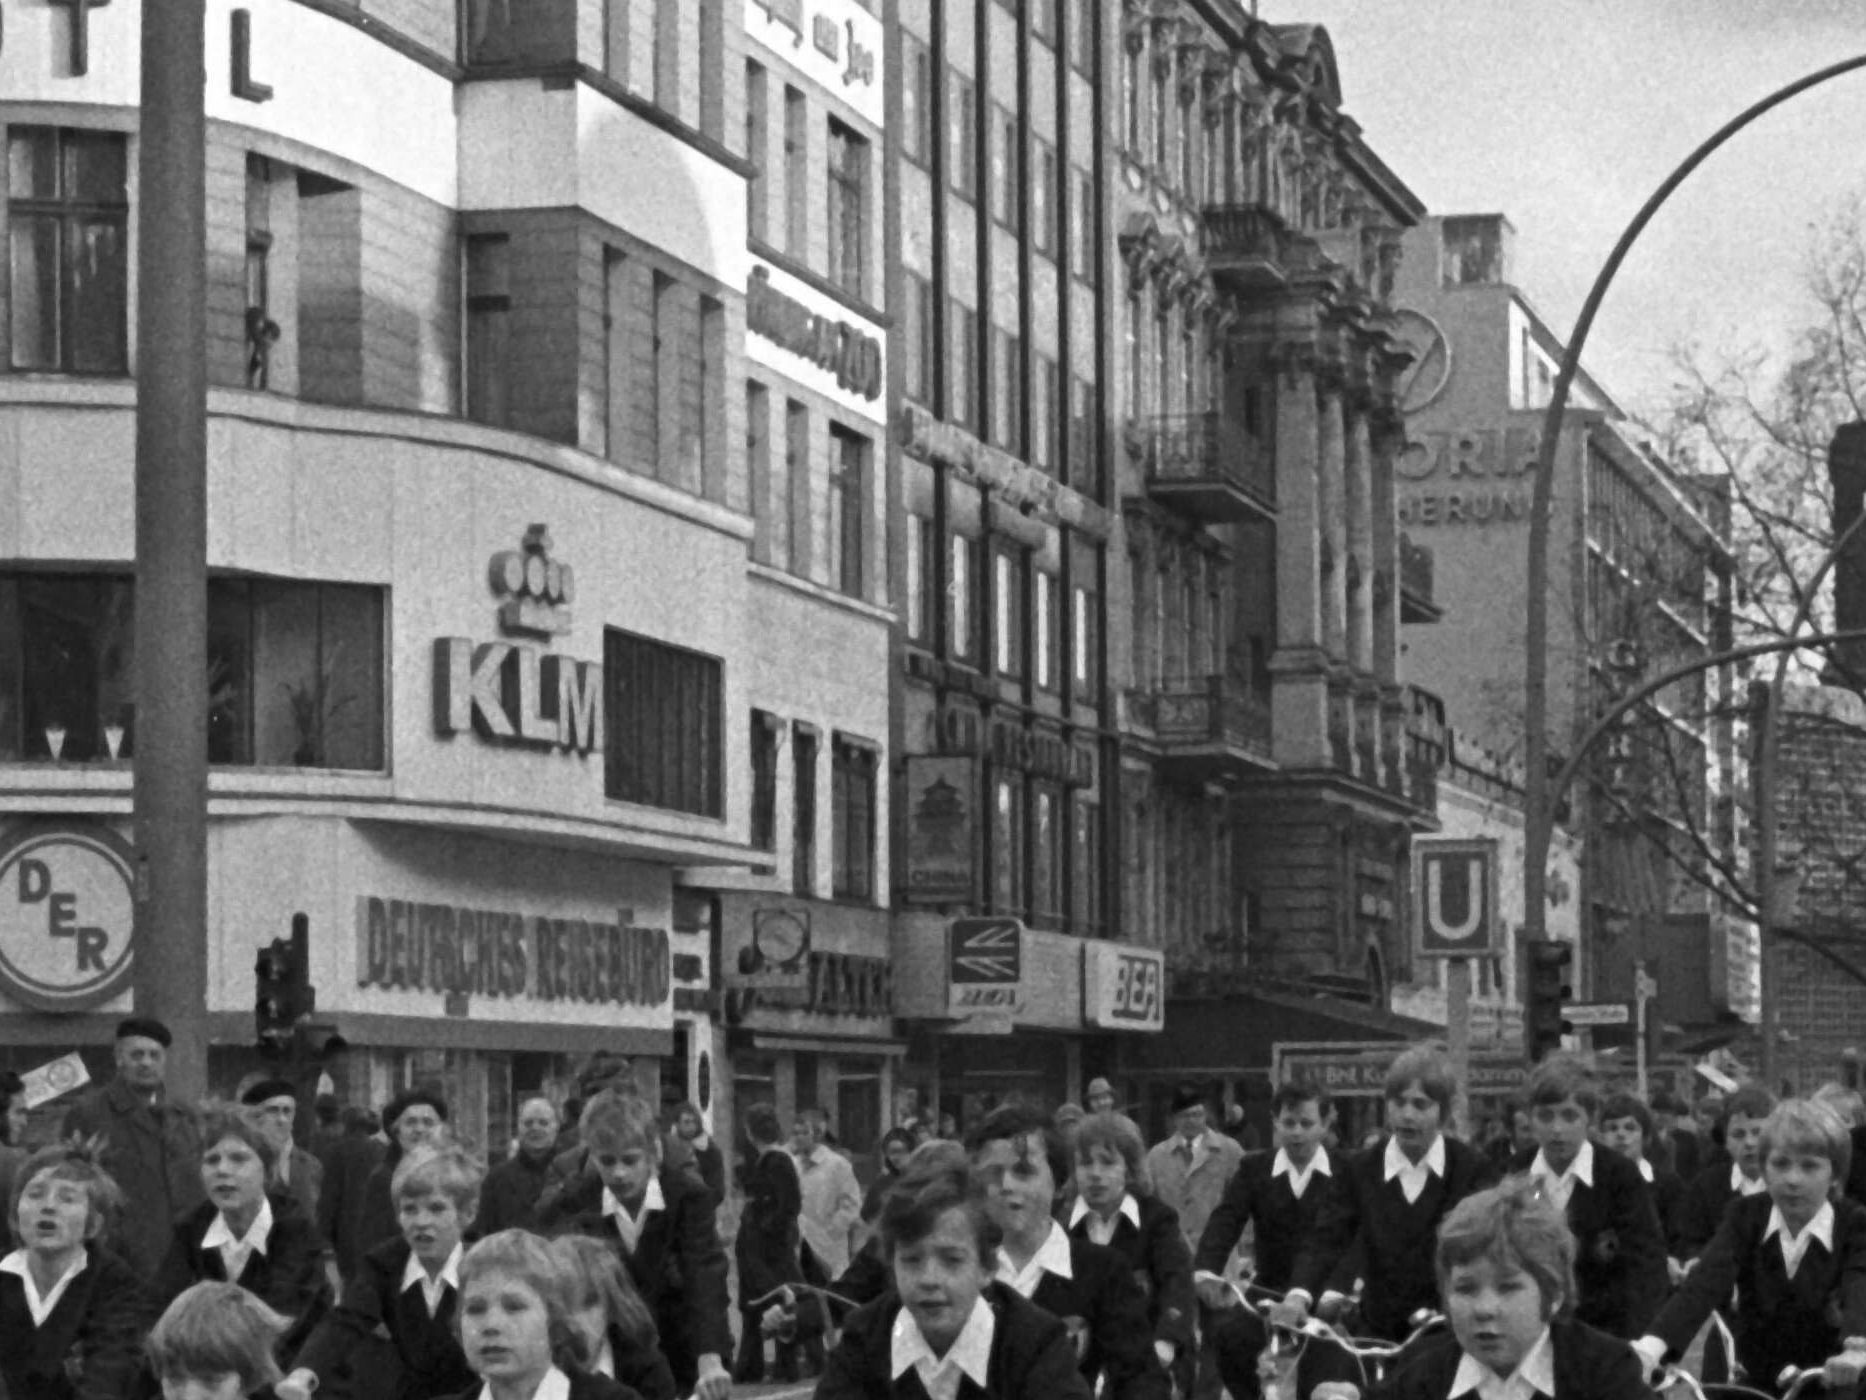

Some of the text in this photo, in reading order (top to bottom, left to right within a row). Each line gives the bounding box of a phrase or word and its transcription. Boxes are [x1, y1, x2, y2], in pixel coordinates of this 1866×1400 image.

[432, 636, 604, 761] KLM
[15, 857, 110, 972] DER
[1428, 859, 1482, 941] U
